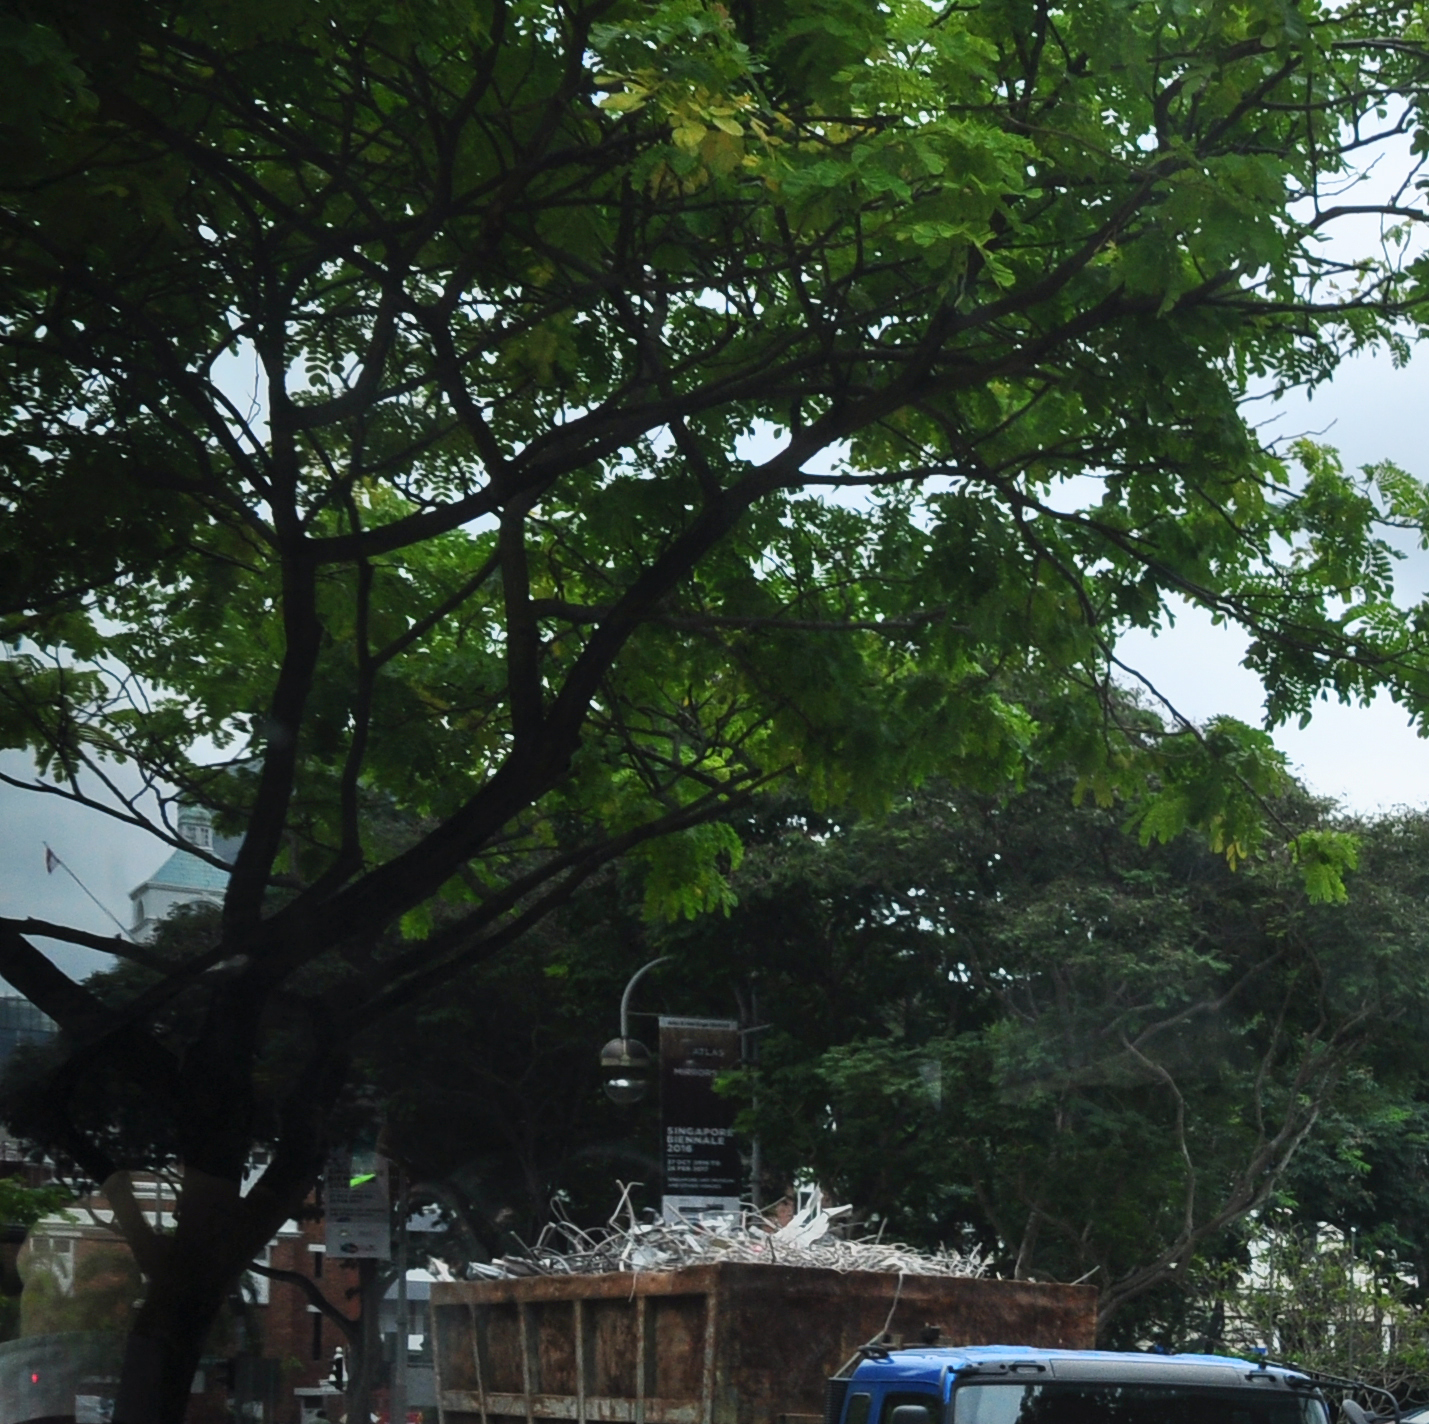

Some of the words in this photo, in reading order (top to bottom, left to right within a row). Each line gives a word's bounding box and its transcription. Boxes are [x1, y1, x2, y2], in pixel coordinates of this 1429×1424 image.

[693, 1048, 725, 1057] ATLAS
[666, 1126, 733, 1137] SINGAPORE
[666, 1135, 725, 1146] BIENNALE
[667, 1144, 693, 1153] 2016
